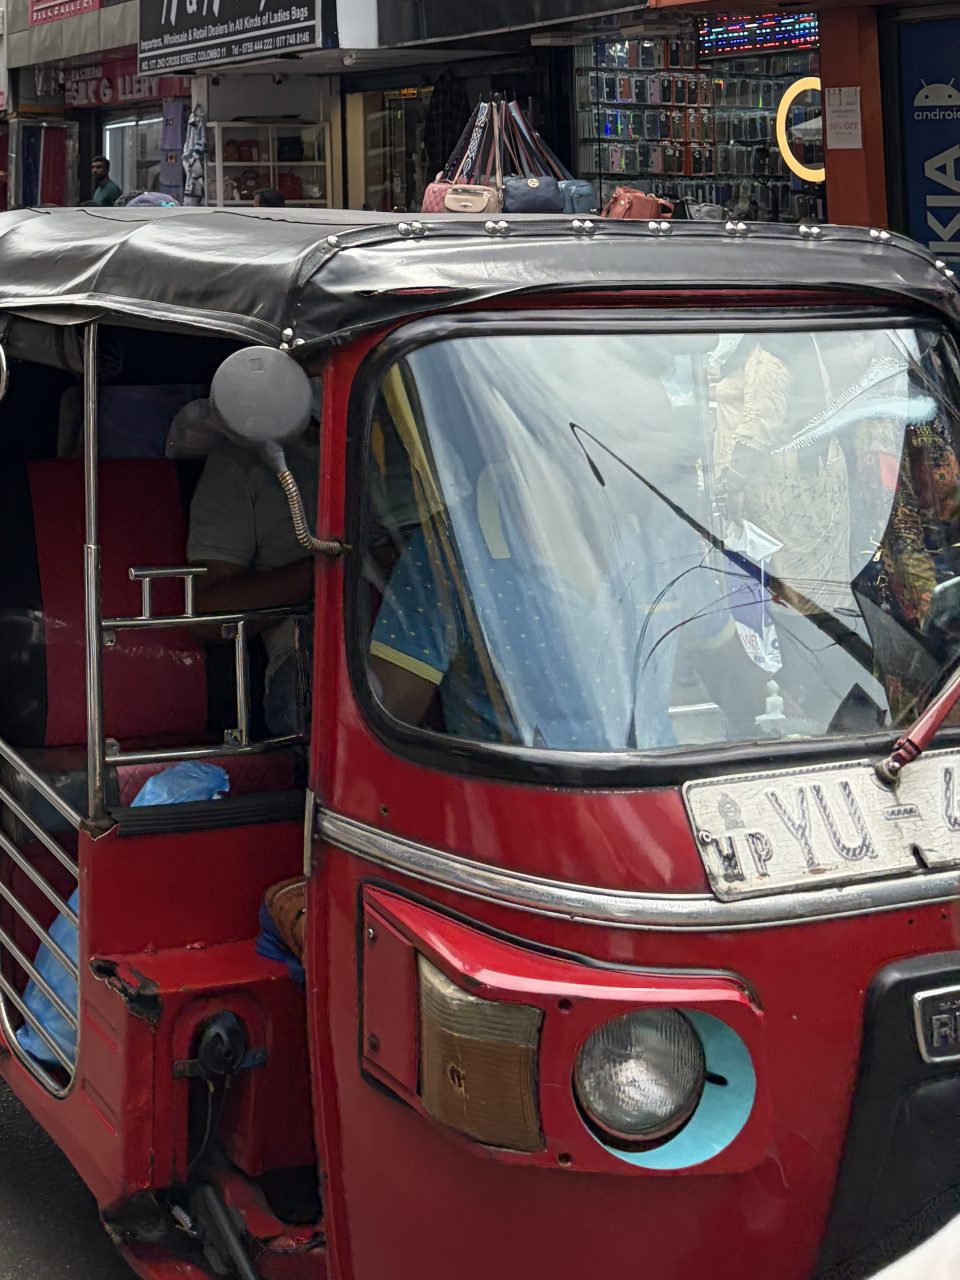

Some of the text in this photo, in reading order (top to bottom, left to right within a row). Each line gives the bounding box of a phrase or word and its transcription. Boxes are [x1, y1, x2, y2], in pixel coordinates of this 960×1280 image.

[163, 30, 187, 46] Wholesale
[193, 25, 208, 38] Retail
[208, 23, 228, 37] Dealers
[235, 20, 243, 31] All
[244, 15, 261, 29] Kinds
[262, 14, 268, 25] of
[270, 10, 290, 25] Ladies
[291, 6, 308, 21] Bags
[166, 56, 180, 67] CROSS
[198, 49, 220, 61] COLOMBO
[712, 831, 773, 882] WP
